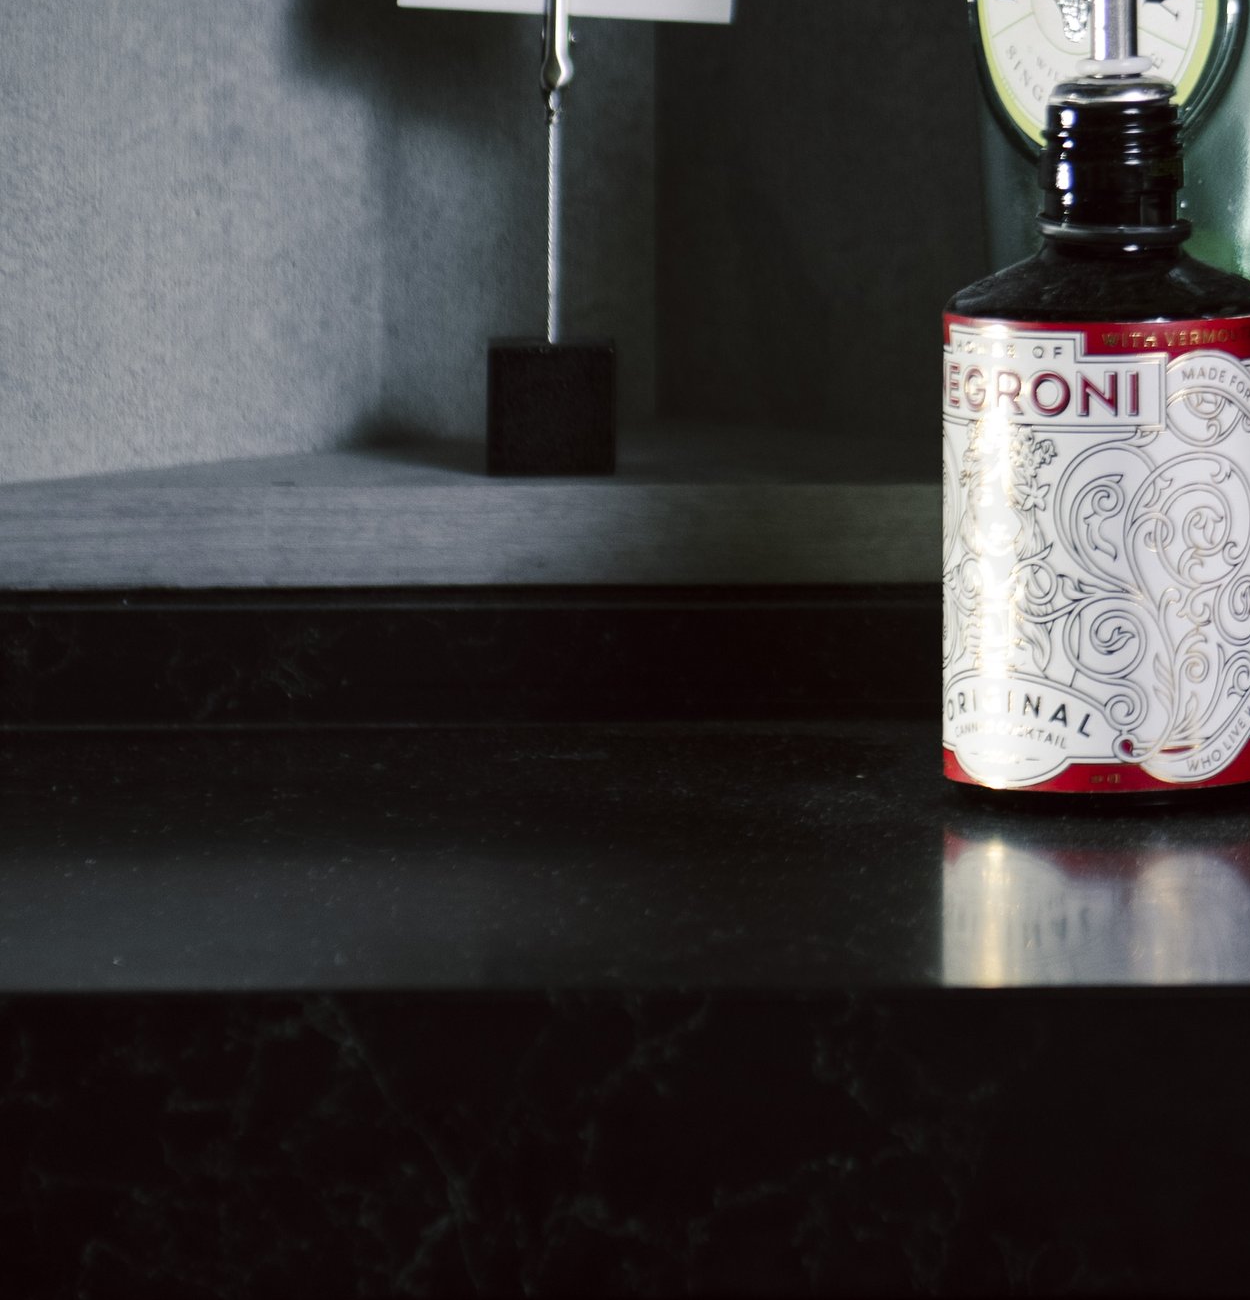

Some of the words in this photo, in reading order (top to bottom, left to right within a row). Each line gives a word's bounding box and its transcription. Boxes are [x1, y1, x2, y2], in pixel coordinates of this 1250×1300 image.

[1101, 331, 1157, 348] WITH
[1031, 345, 1063, 360] OF
[1180, 366, 1226, 384] MADE
[945, 687, 1091, 739] ORIINAL
[1186, 749, 1222, 773] WHO
[1222, 719, 1246, 751] LIVE
